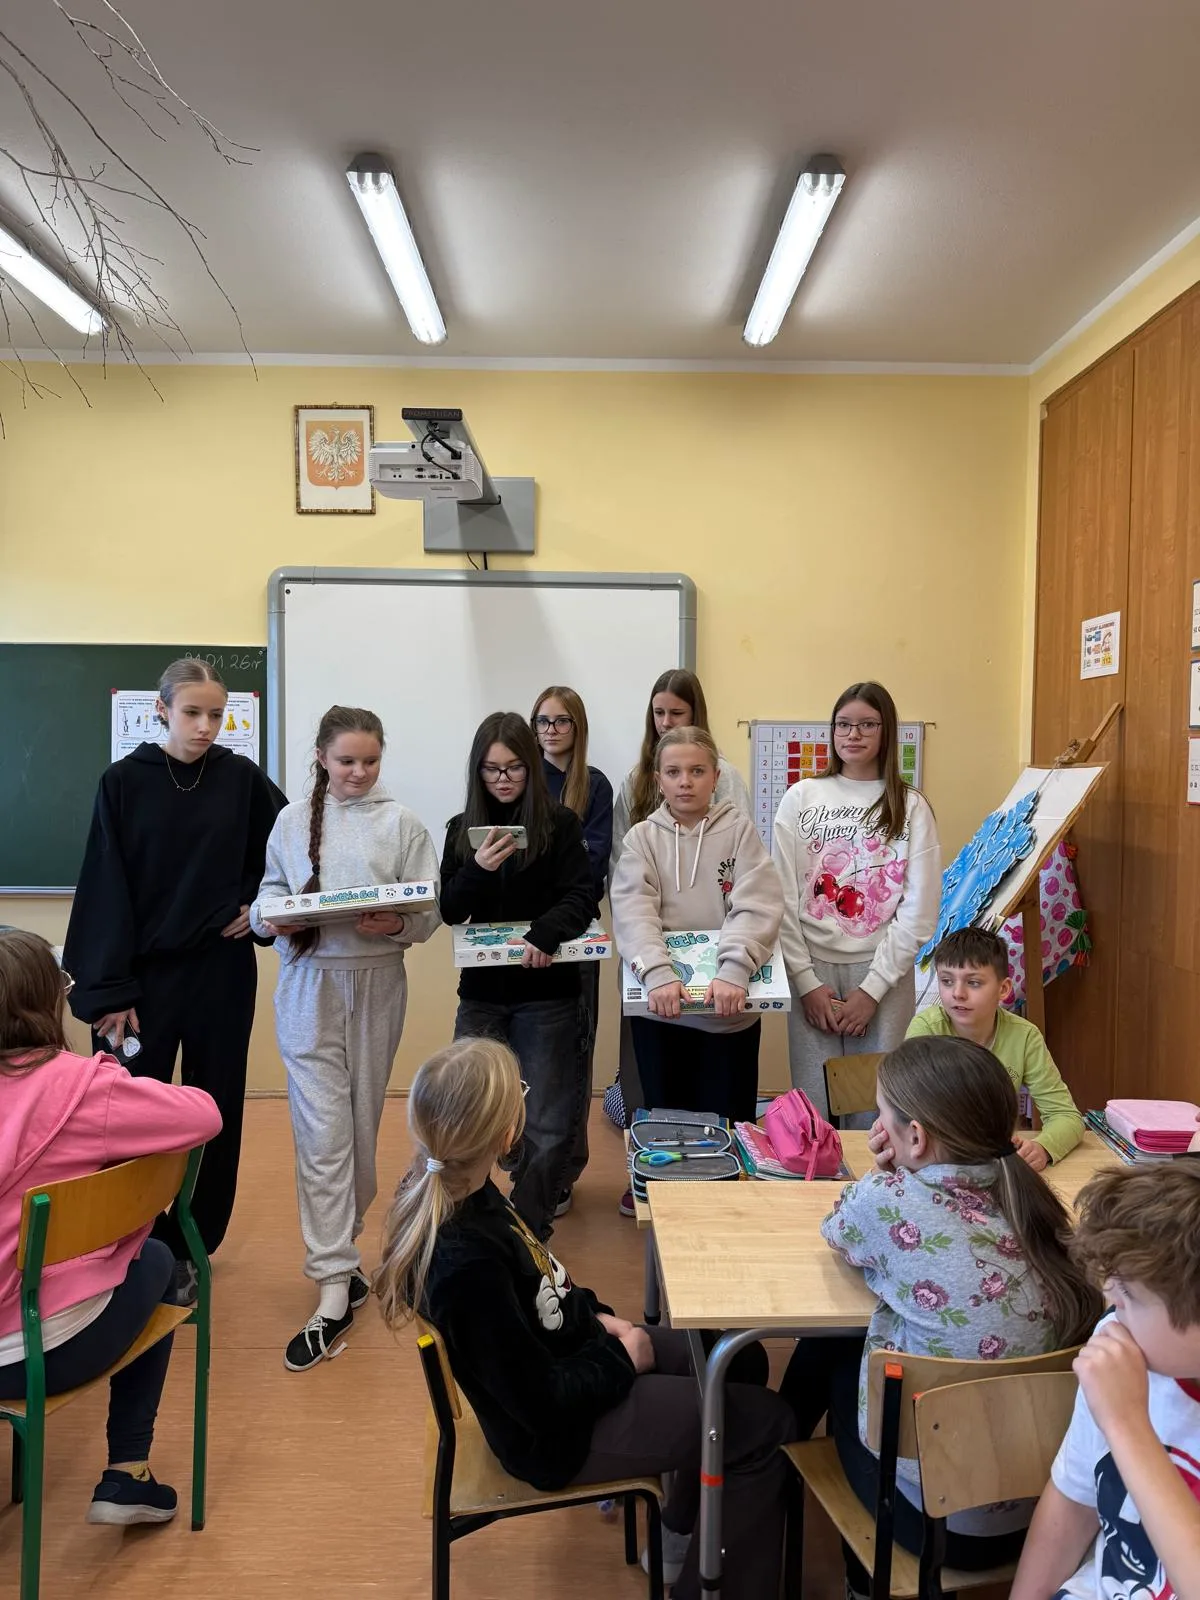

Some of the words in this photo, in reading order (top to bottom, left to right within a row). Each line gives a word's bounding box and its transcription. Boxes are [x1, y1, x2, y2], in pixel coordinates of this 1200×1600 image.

[905, 732, 914, 740] 10
[798, 805, 870, 840] Cherry
[811, 822, 858, 854] Juicy
